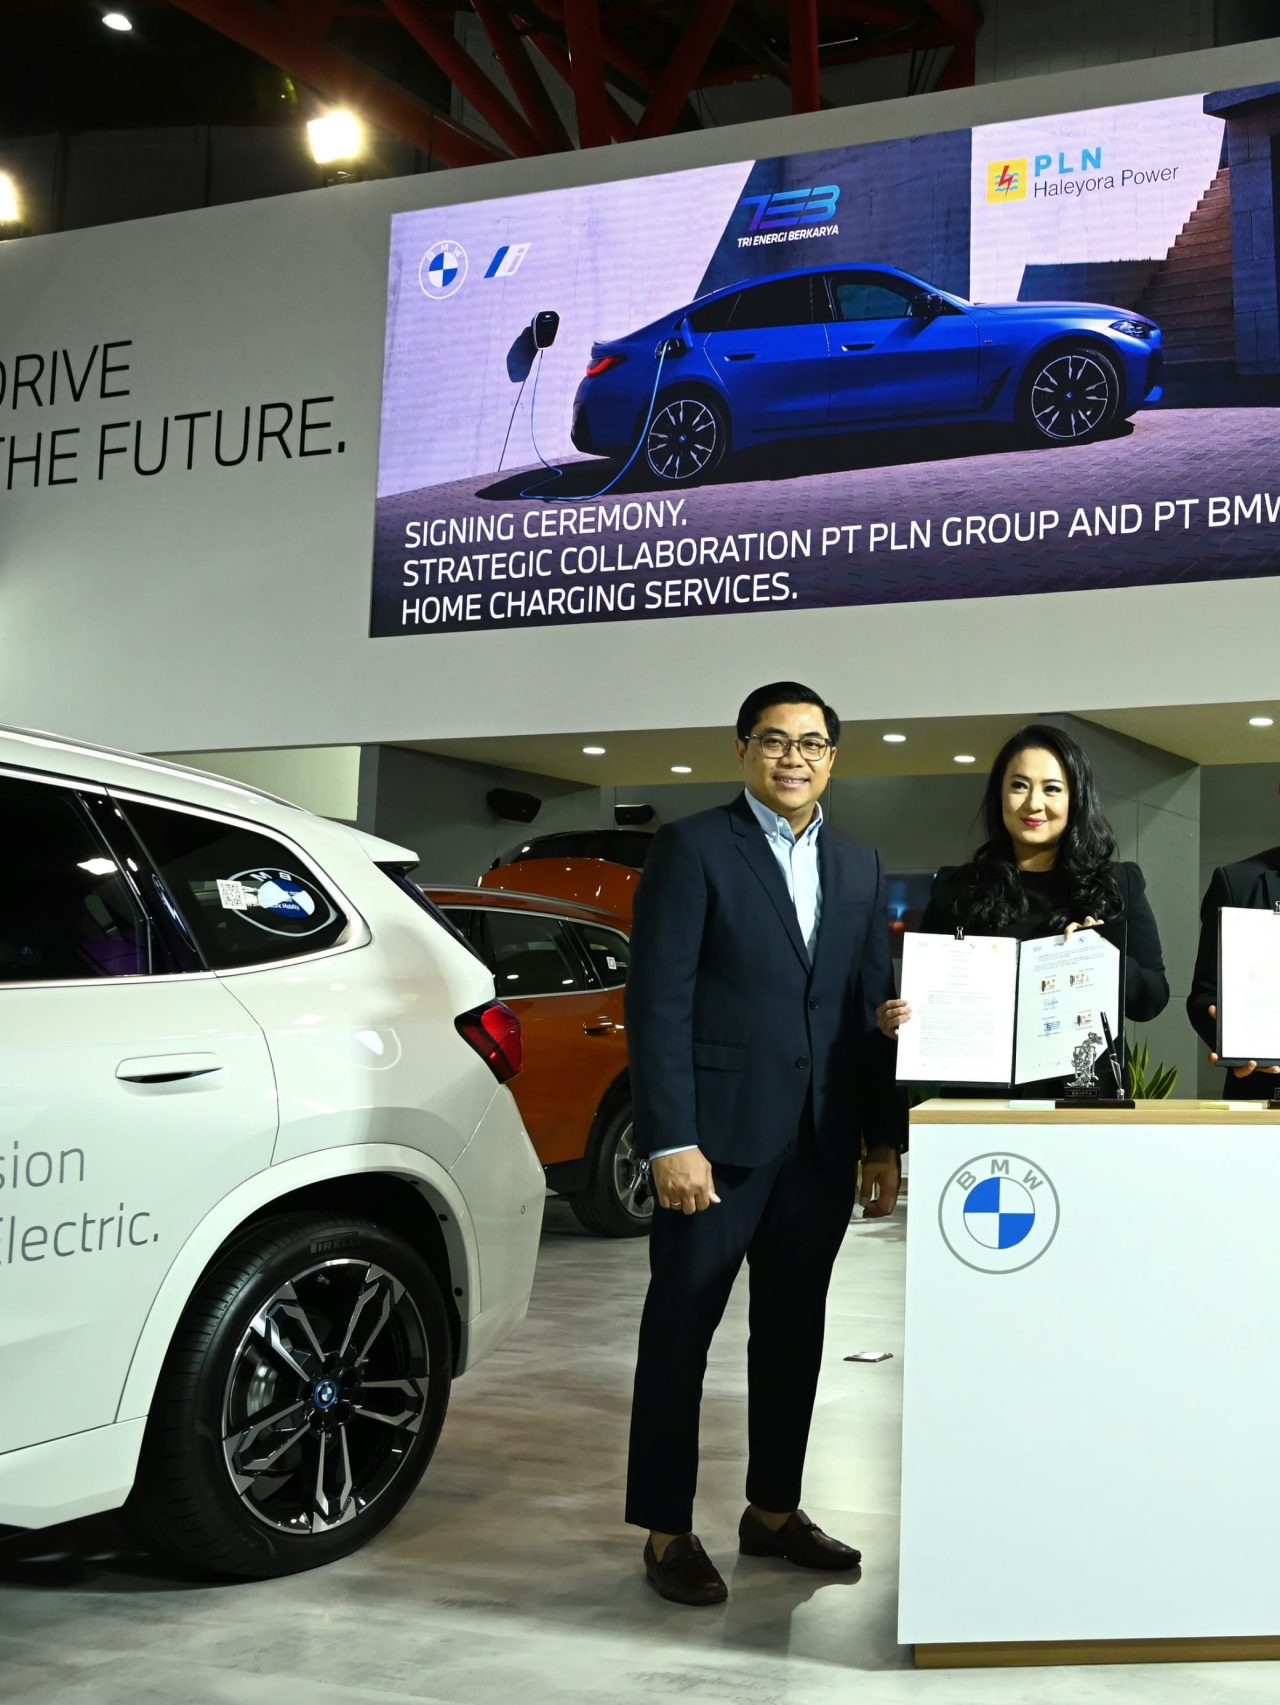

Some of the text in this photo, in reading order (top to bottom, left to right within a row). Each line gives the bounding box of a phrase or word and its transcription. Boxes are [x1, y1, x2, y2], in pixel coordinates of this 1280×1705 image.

[1034, 147, 1102, 177] PLN
[1034, 166, 1180, 199] Haleyora Power
[737, 224, 839, 249] TRI ENERGI BERKARYA
[0, 340, 132, 410] RIVE
[99, 396, 346, 480] FUTURE.
[403, 548, 553, 587] STRATEGIC
[560, 528, 811, 575] COLLABORATION
[821, 525, 862, 556] PT
[869, 520, 931, 552] PLN
[942, 510, 1059, 547] GROUP
[1067, 504, 1143, 538] AND
[1154, 498, 1200, 532] PT
[405, 498, 688, 549] SIGNING CEREMONY.
[402, 572, 798, 625] HOME CHARGING SERVICES.
[0, 1140, 84, 1190] ion
[956, 1159, 1044, 1191] BMW
[0, 1202, 159, 1266] lectric.
